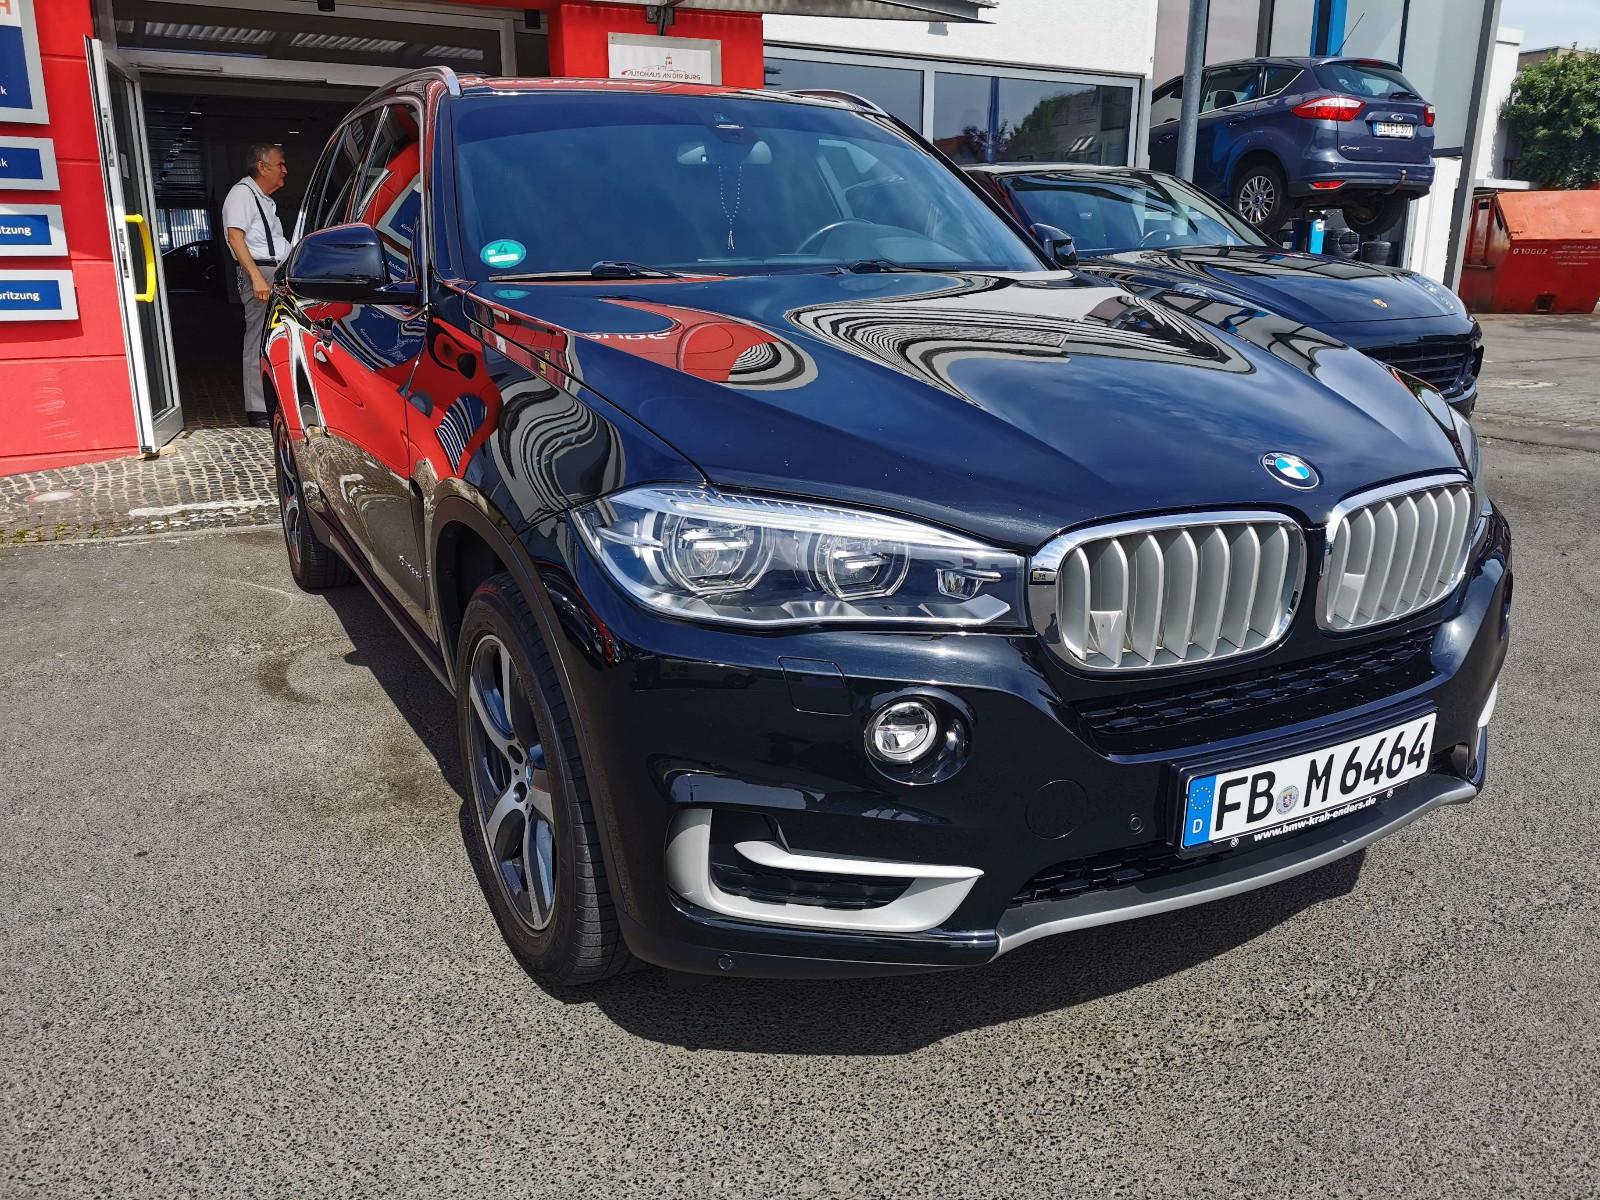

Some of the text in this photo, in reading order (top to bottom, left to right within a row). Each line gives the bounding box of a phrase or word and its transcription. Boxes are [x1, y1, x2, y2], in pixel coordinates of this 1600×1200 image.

[0, 226, 32, 236] tzung
[1214, 721, 1429, 831] FB M 6464
[1192, 818, 1203, 834] D
